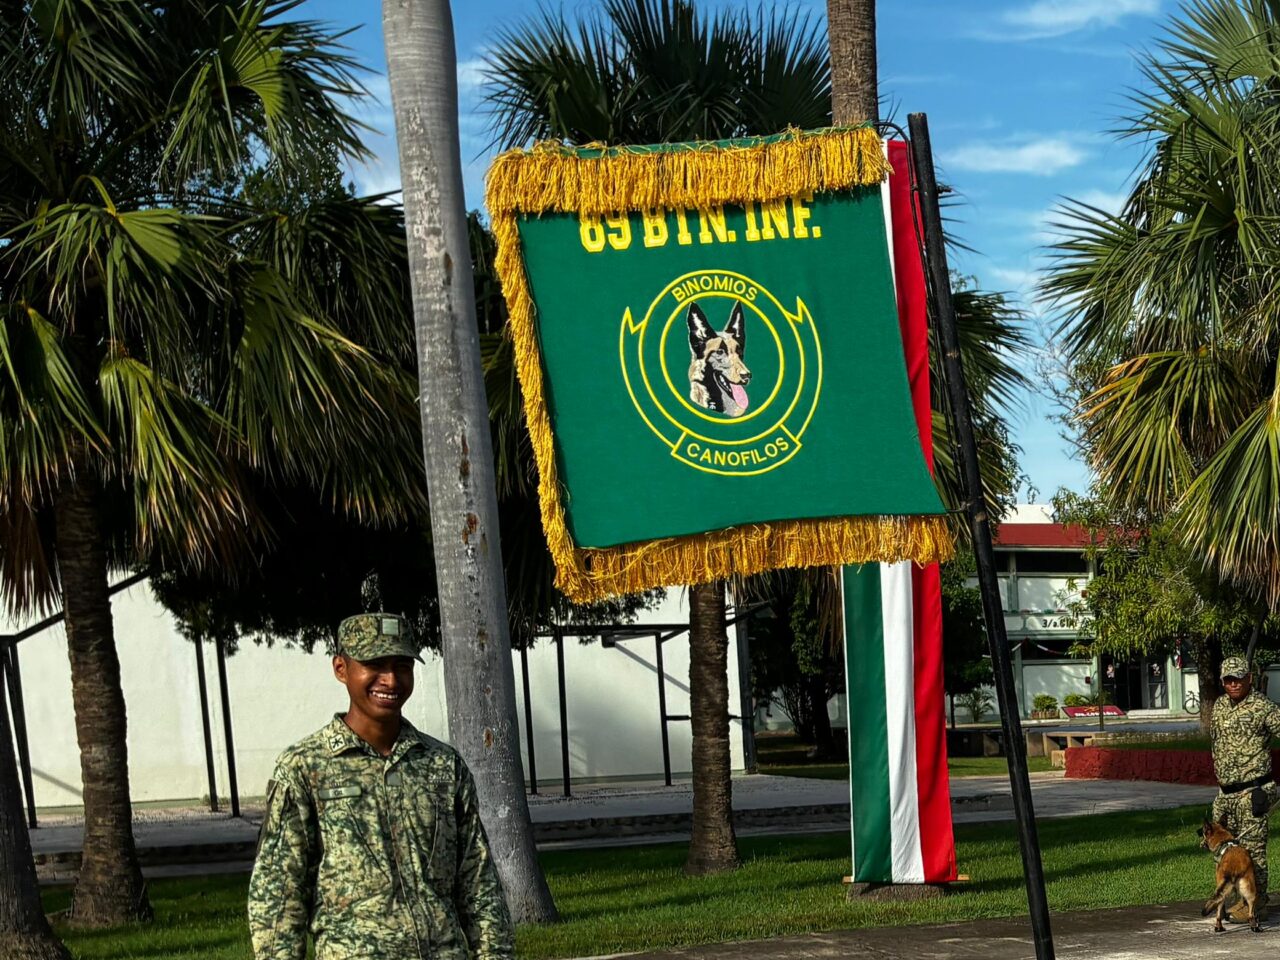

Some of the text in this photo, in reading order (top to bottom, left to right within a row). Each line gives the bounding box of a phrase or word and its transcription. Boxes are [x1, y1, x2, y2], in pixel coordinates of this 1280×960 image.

[745, 190, 822, 242] INF.
[671, 275, 758, 302] BINOMIOS
[686, 437, 789, 466] CANOFILOS
